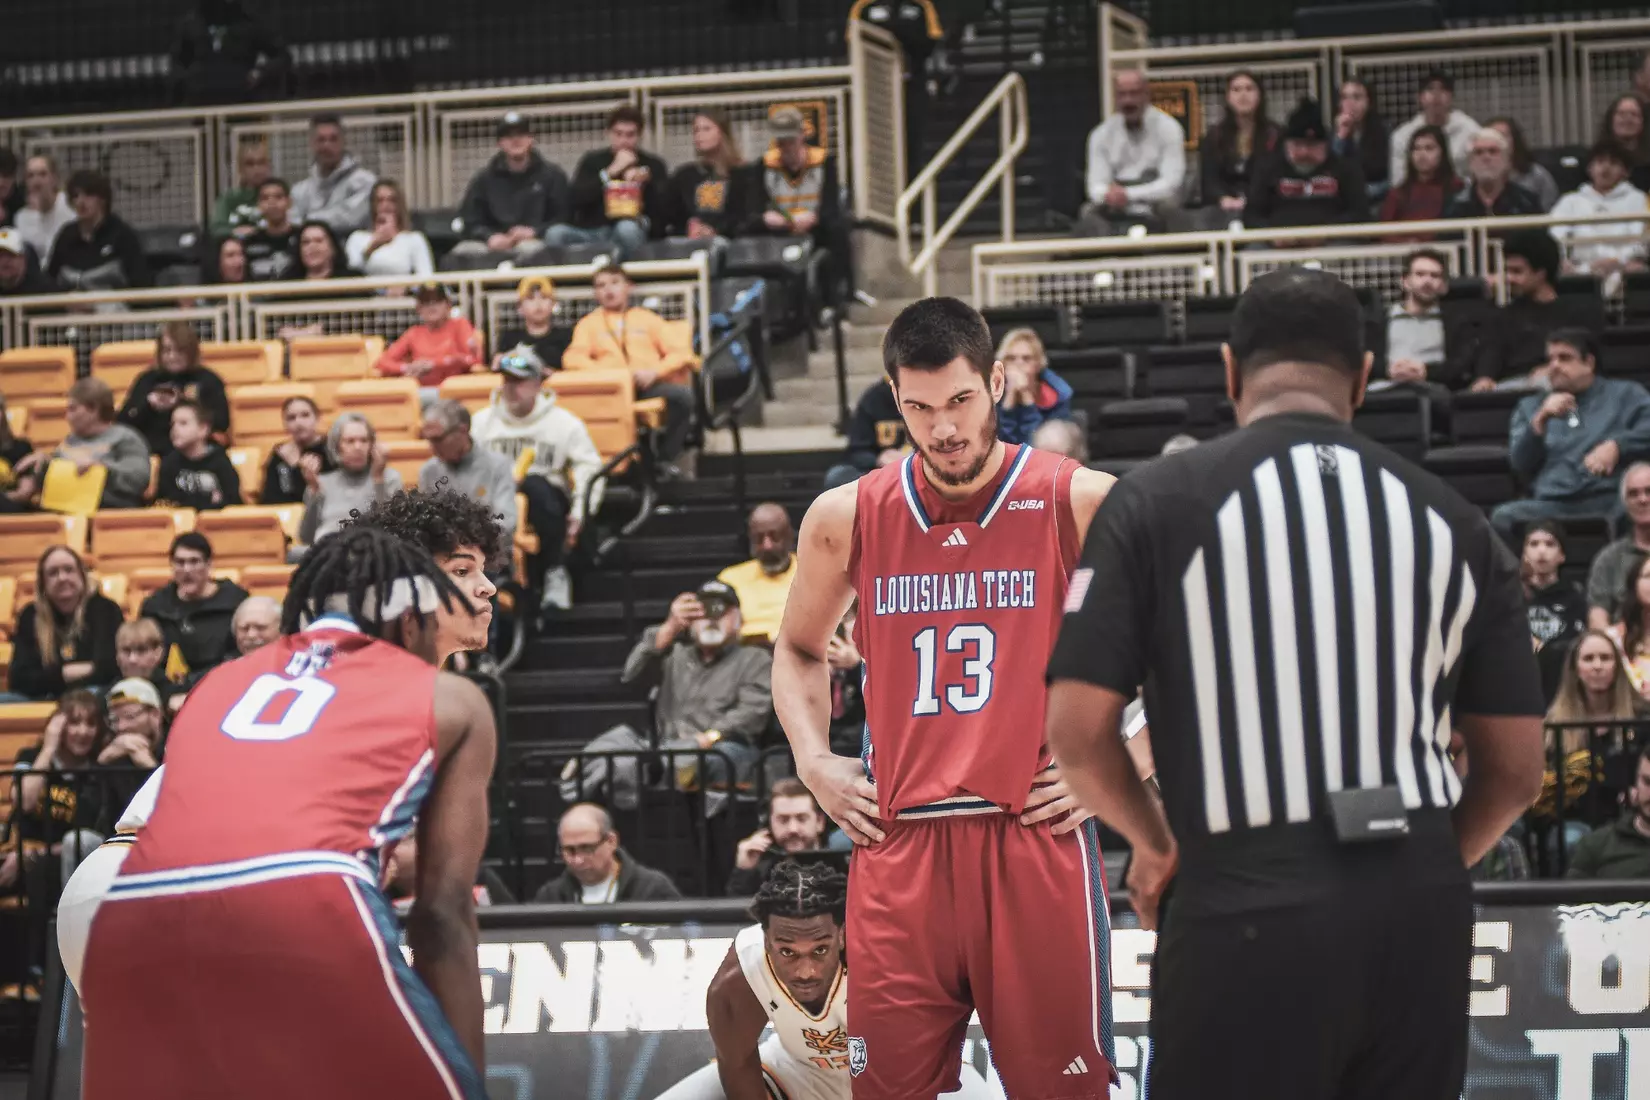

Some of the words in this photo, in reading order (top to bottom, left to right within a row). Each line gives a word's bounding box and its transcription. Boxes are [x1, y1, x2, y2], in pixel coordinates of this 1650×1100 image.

[875, 571, 978, 616] LOUISIANA
[981, 569, 1036, 609] TECH
[912, 622, 997, 717] 13
[218, 672, 338, 743] 0
